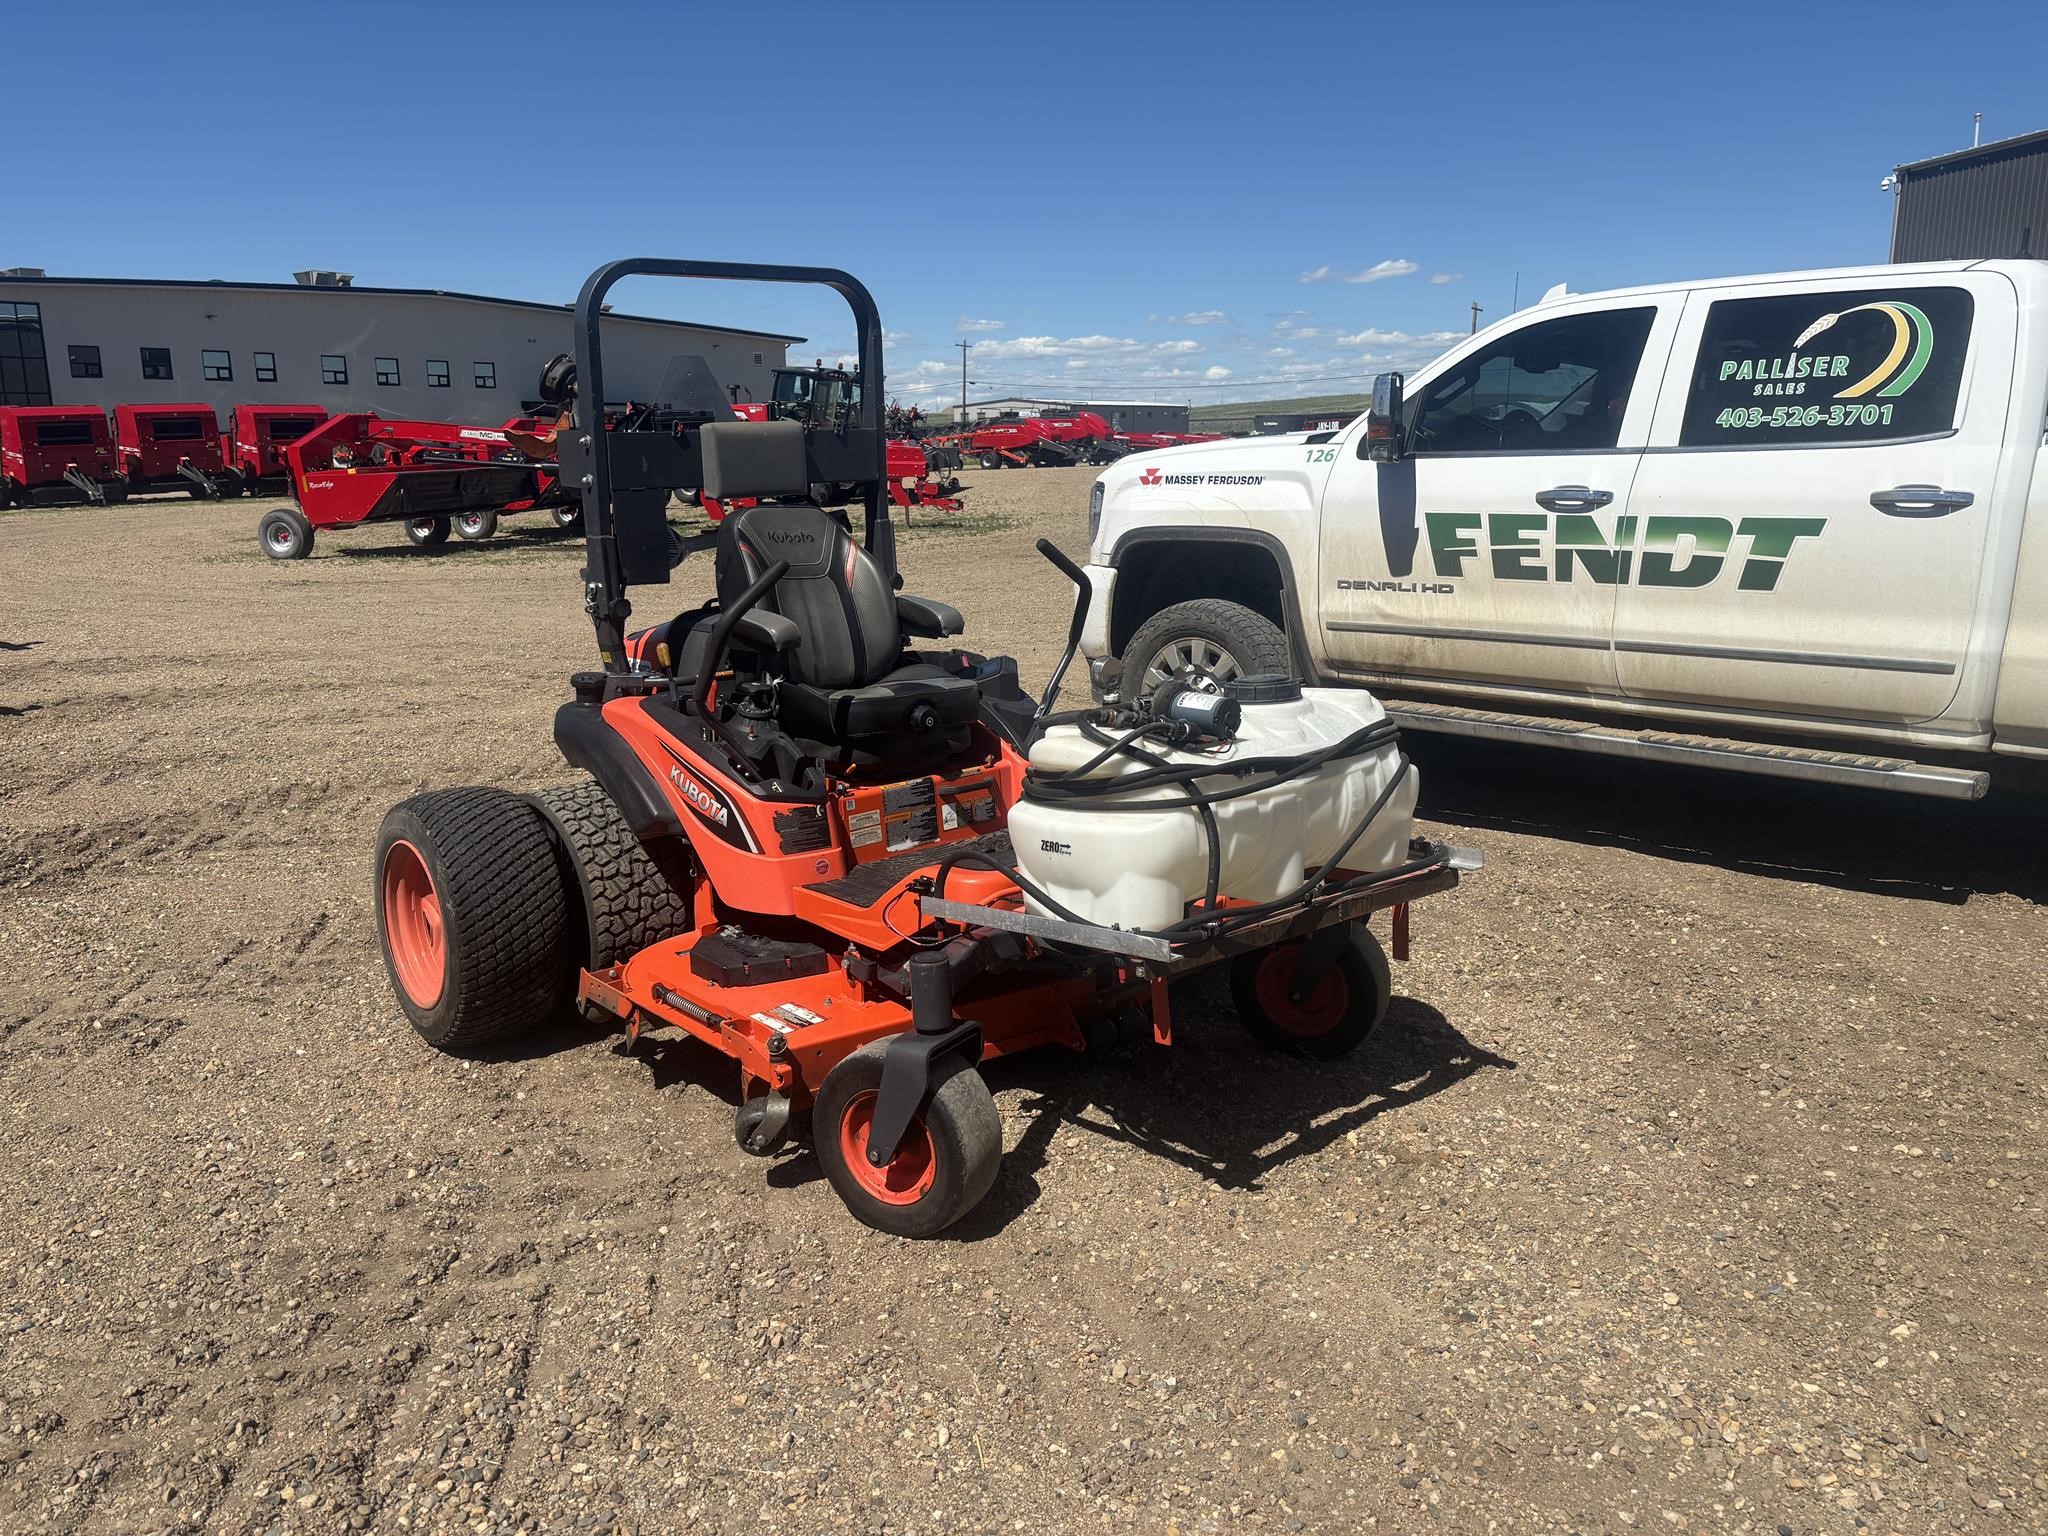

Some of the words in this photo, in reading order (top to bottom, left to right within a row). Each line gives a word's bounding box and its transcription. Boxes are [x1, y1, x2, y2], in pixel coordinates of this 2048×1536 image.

[1719, 353, 1850, 381] PALLISER
[1753, 382, 1806, 396] SALES
[1716, 403, 1894, 428] 403-526-3701
[1305, 448, 1336, 463] 126
[1165, 475, 1206, 485] MASSEY
[1207, 475, 1263, 486] FERGUSON
[767, 531, 815, 544] Kubota
[1423, 510, 1830, 593] FENDT
[1337, 580, 1418, 593] DENALI
[1421, 583, 1455, 594] HD
[670, 764, 728, 828] KUBOTA
[1040, 839, 1060, 854] ZERO
